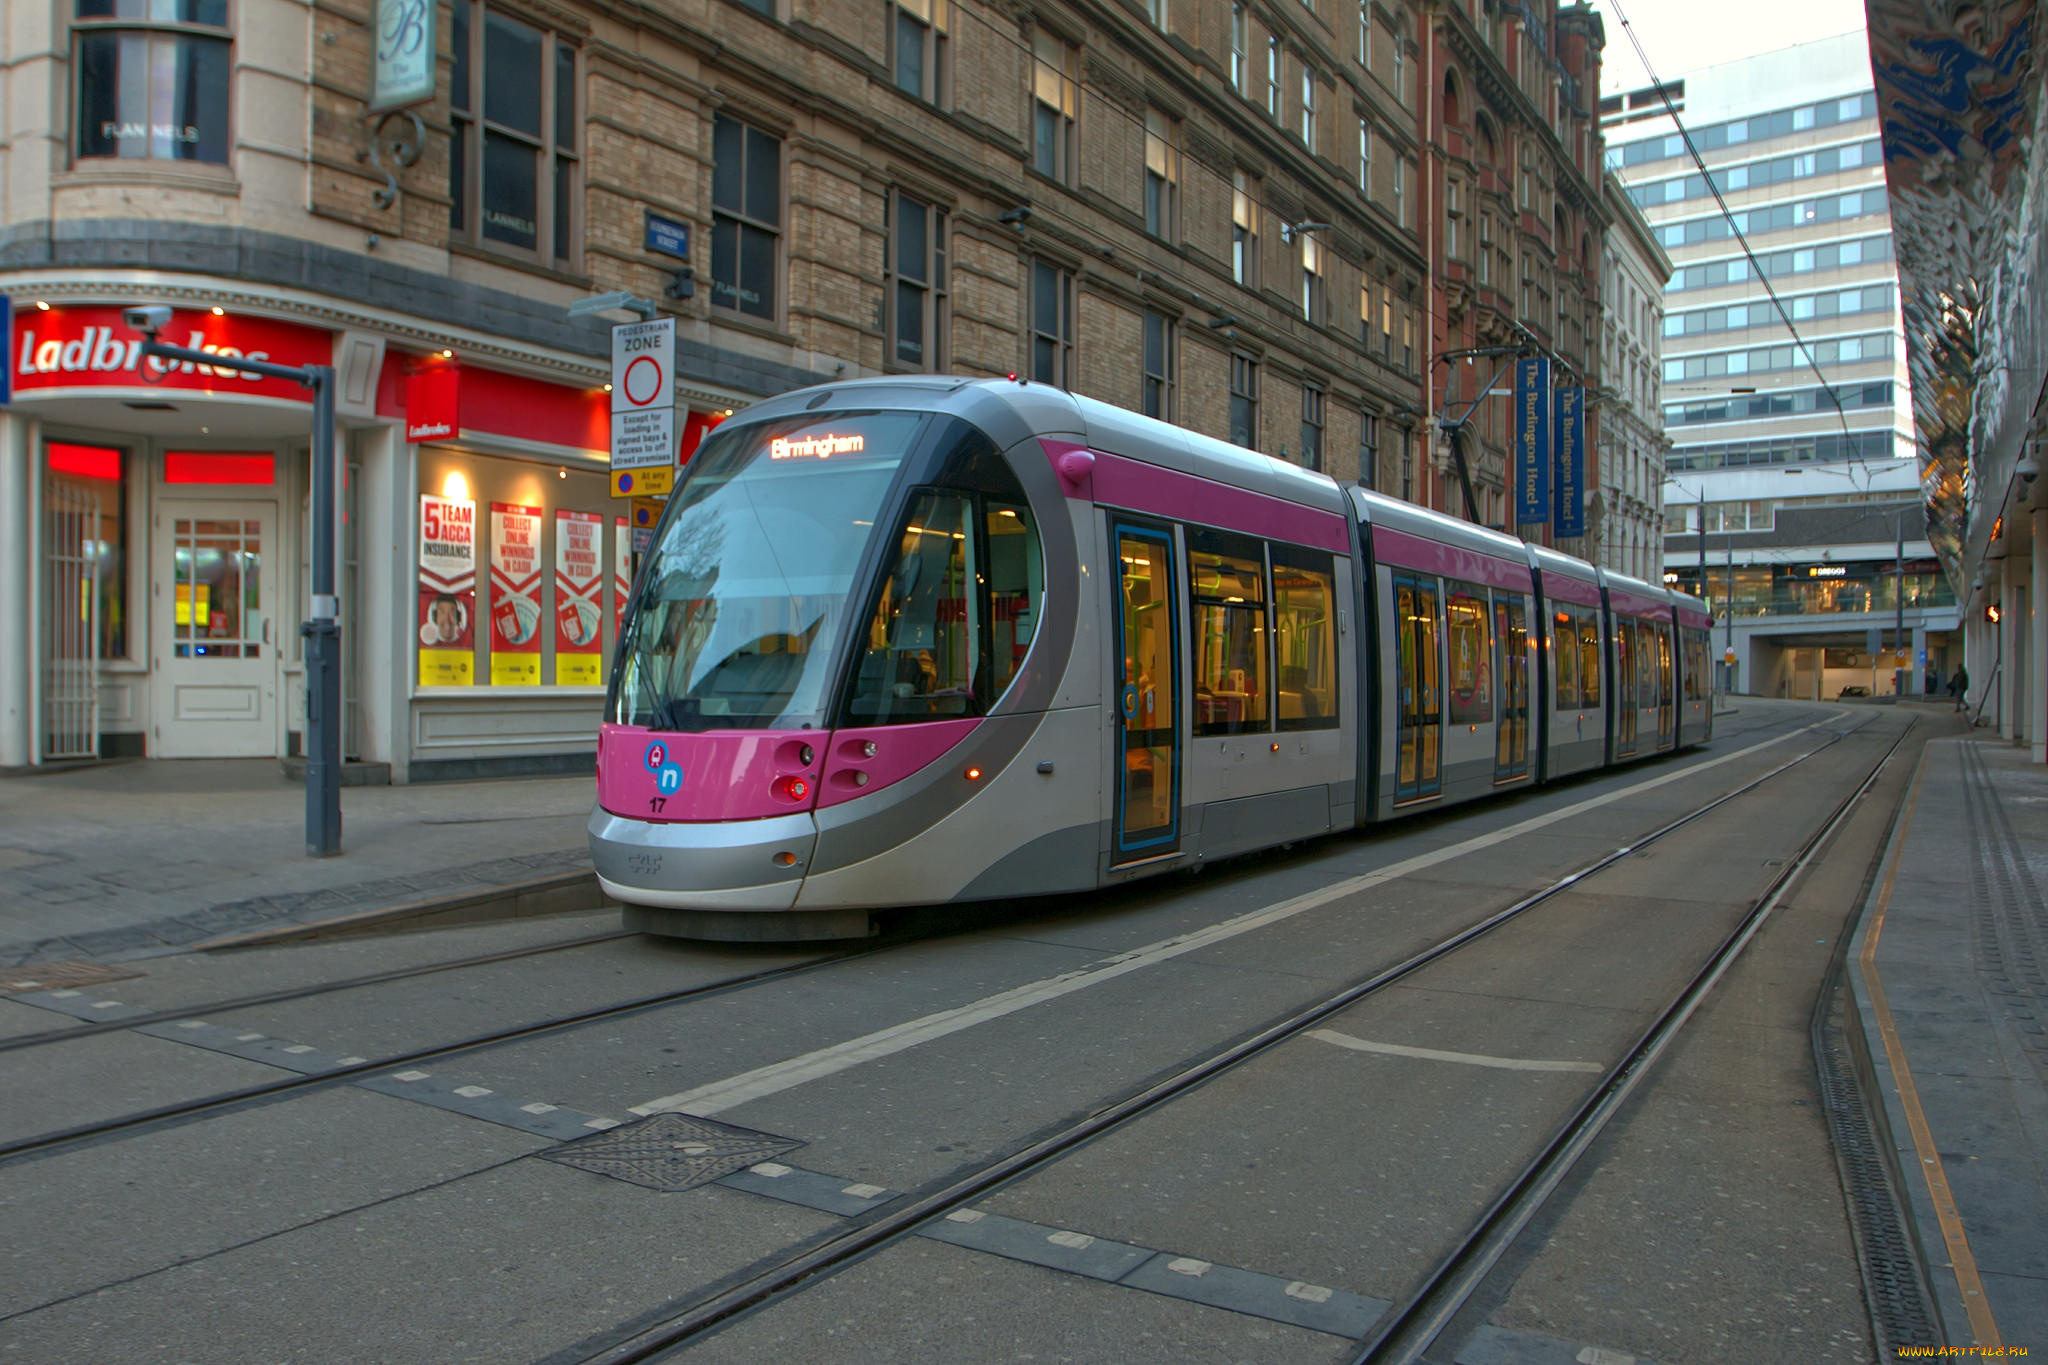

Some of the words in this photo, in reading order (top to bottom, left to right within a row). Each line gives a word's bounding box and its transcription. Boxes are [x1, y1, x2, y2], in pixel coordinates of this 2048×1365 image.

[102, 122, 199, 143] FLANNELS
[617, 322, 669, 337] PEDESTRIAN
[624, 335, 661, 352] ZONE
[18, 326, 269, 381] Ladbrokes
[1526, 362, 1538, 389] The
[1563, 390, 1575, 415] The
[623, 414, 649, 425] Except
[651, 412, 661, 421] for
[1523, 392, 1538, 463] Burlington
[409, 422, 450, 437] Ladbrokes
[623, 424, 651, 434] loading
[653, 423, 660, 432] in
[643, 434, 660, 443] bays
[645, 445, 653, 453] to
[654, 443, 666, 452] off
[771, 433, 864, 459] Birmingham
[1561, 418, 1575, 483] Burlington
[1526, 468, 1538, 505] Hotel
[1563, 487, 1575, 520] Hotel
[425, 502, 439, 540] 5
[442, 504, 471, 524] TEAM
[503, 515, 531, 531] COLLECT
[441, 524, 471, 543] ACCA
[424, 543, 471, 559] INSURANCE
[661, 769, 678, 788] n
[650, 797, 667, 813] 17
